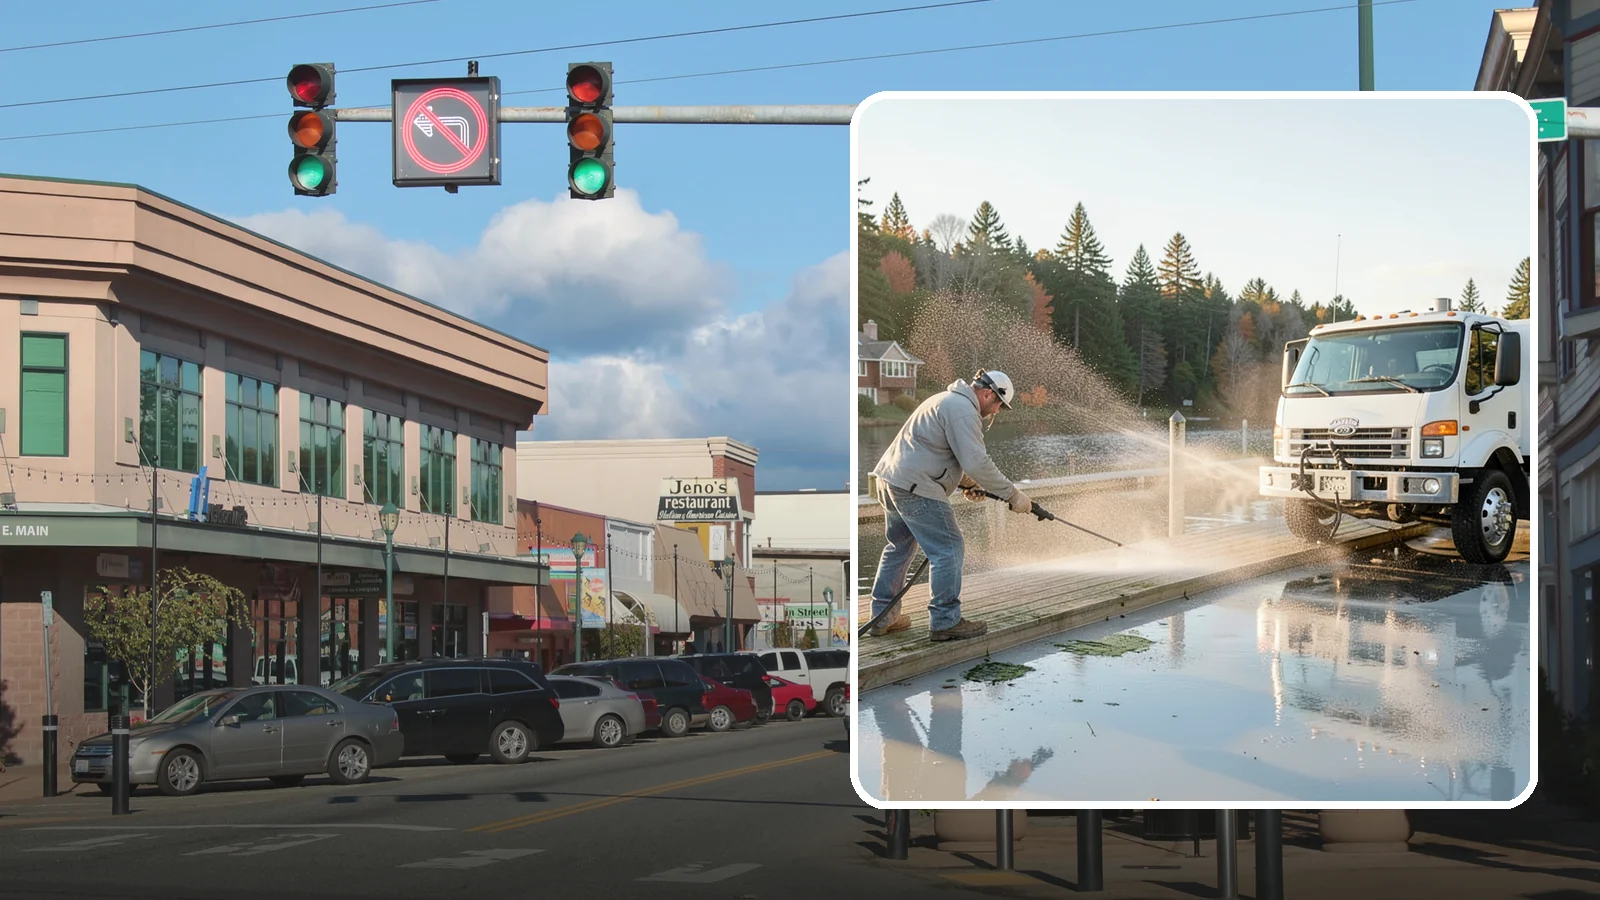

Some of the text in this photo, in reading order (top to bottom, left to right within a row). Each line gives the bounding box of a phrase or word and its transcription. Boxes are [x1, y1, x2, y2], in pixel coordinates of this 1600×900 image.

[670, 480, 727, 494] Jeno's
[664, 496, 731, 509] restaurant
[659, 510, 682, 520] Italian
[686, 510, 714, 519] American
[715, 509, 737, 519] Cuisine
[2, 525, 49, 536] E. MAIN
[797, 607, 829, 616] Street
[791, 619, 824, 627] lass
